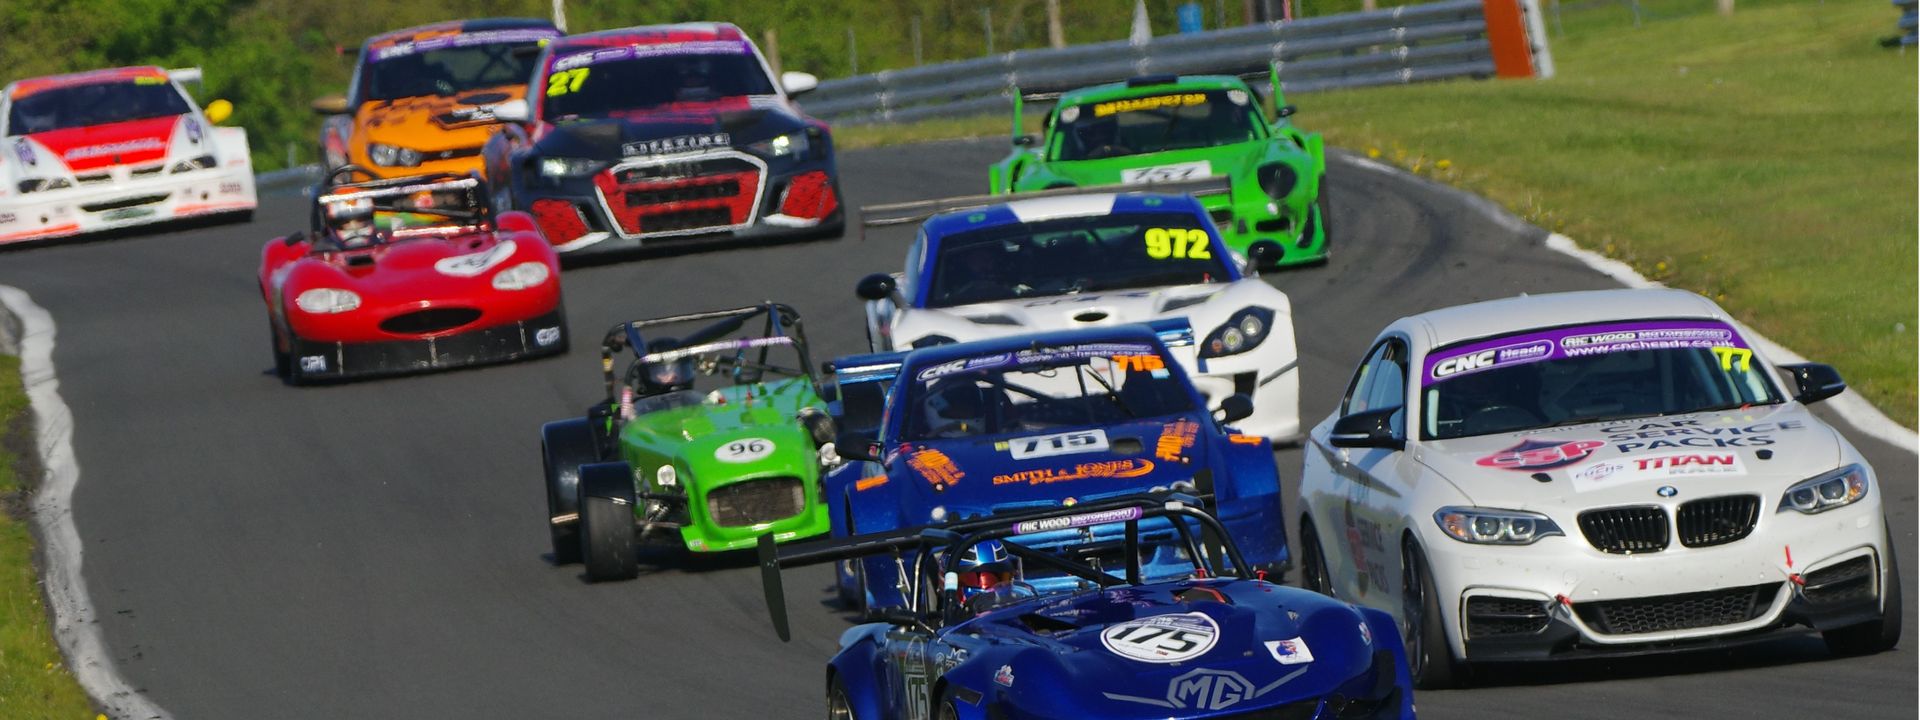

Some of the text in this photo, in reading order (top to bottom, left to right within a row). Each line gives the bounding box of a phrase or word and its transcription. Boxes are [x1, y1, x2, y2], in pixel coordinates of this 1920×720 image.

[546, 67, 590, 97] 27
[1144, 227, 1211, 259] 972
[1564, 338, 1736, 357] www.cncheads.co.uk
[1565, 336, 1591, 347] RIC
[1591, 332, 1636, 343] WOOD
[920, 359, 967, 379] CNC
[1112, 354, 1165, 372] 715
[1436, 344, 1546, 377] CNC Heads
[1711, 346, 1753, 372] 77
[1600, 417, 1702, 433] CAR
[1607, 419, 1807, 443] SERVICE
[730, 439, 765, 456] 96
[1022, 431, 1099, 453] 715
[1616, 435, 1775, 453] PACKS
[993, 469, 1053, 485] SMITH
[1058, 469, 1068, 477] &
[1075, 459, 1134, 476] JONES
[1574, 464, 1624, 480] FUCHS
[1632, 454, 1735, 472] TITAN
[1021, 521, 1038, 532] RIC
[1039, 517, 1071, 530] WOOD
[1071, 509, 1132, 523] MOTORSPORT
[1109, 625, 1209, 653] 175
[907, 676, 928, 720] 175
[1178, 675, 1243, 710] MG
